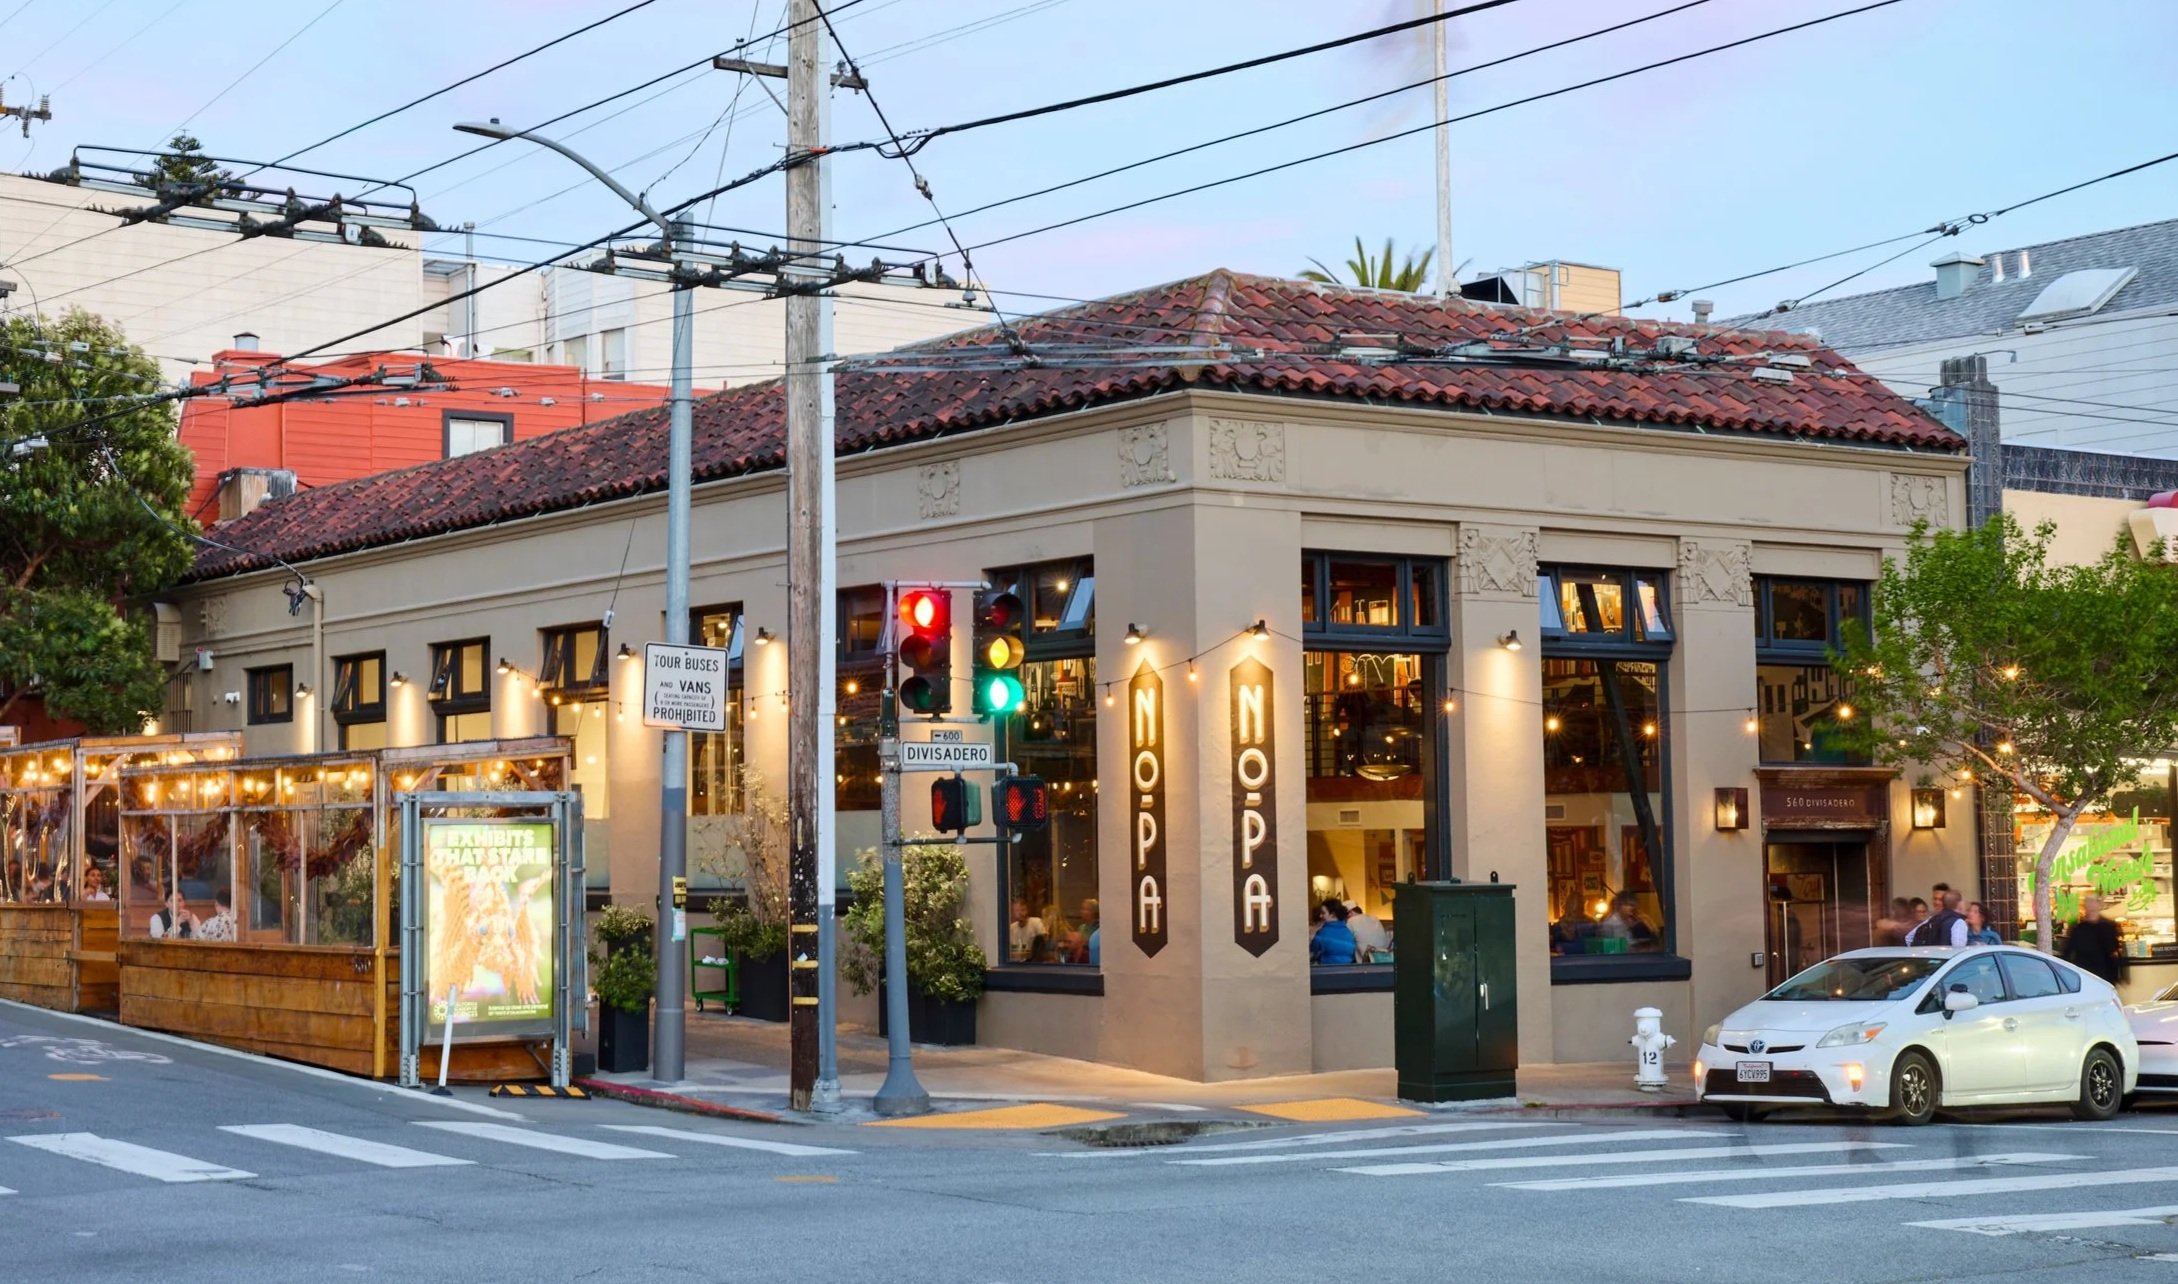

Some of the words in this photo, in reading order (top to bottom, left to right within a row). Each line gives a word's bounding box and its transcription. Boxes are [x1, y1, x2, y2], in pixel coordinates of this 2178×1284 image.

[654, 654, 681, 669] TOUR
[685, 657, 719, 672] BUSES
[679, 680, 711, 694] VANS
[653, 706, 716, 723] PROHIBITED
[943, 731, 960, 741] 600
[907, 747, 987, 761] DIVISADERO
[1786, 797, 1805, 808] 560
[1806, 798, 1855, 808] DIVISADERO
[447, 829, 535, 848] EXHIBITS
[487, 847, 548, 865] STARE
[2028, 805, 2140, 894] nsational
[463, 865, 519, 883] BACK
[1643, 1051, 1657, 1065] 12
